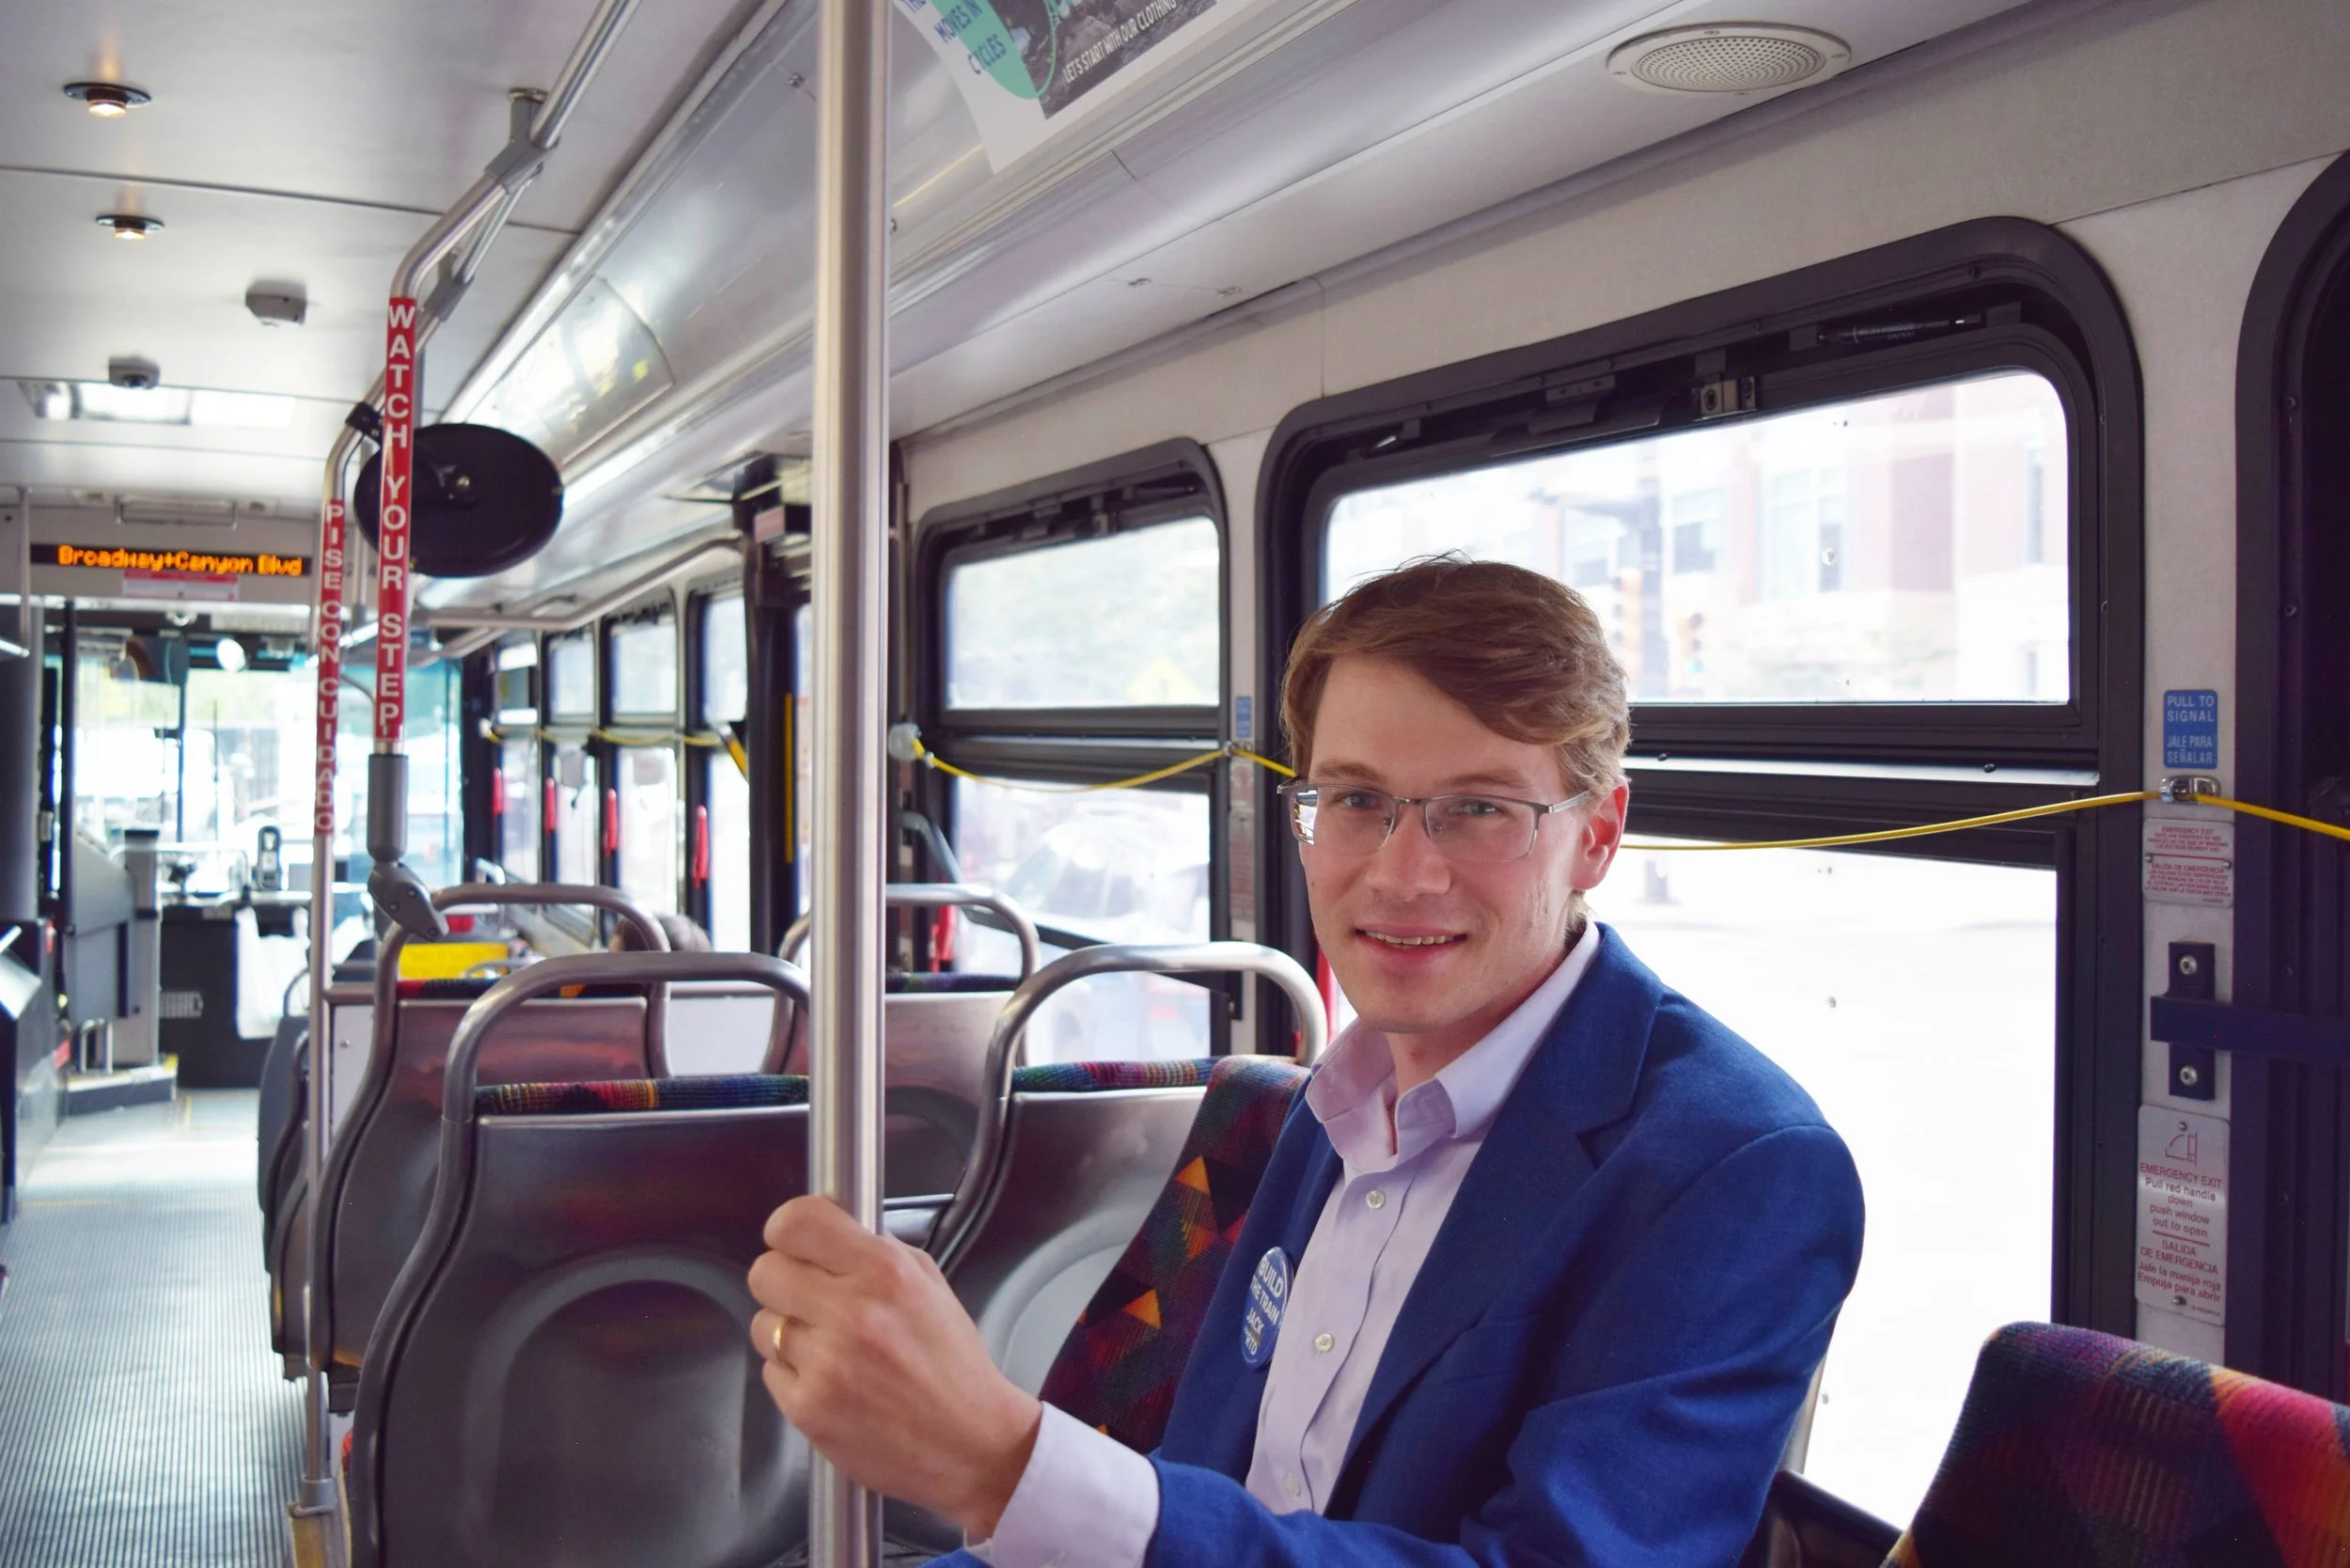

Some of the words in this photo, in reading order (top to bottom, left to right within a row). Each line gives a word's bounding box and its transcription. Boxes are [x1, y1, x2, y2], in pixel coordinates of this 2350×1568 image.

[933, 5, 972, 44] MOVES
[967, 33, 1007, 75] CYCLES
[1081, 40, 1104, 71] START
[1103, 29, 1123, 55] WITH
[1120, 18, 1140, 42] OUR
[387, 305, 415, 448] WATCH
[382, 476, 407, 589] YOUR
[323, 505, 344, 589] PISE
[258, 554, 302, 576] Blvd
[320, 601, 341, 663] CON
[2167, 696, 2194, 707] PULL
[2199, 696, 2215, 707] TO
[2167, 710, 2215, 722] SIGNAL
[2167, 735, 2187, 747] JALE
[2189, 735, 2213, 748] PARA
[2167, 748, 2213, 764] SEÑALAR
[2139, 1162, 2199, 1184] EMERGENCY
[2201, 1176, 2222, 1188] EXIT
[2145, 1177, 2163, 1189] Pull
[2165, 1182, 2181, 1193] red
[2184, 1185, 2217, 1201] handle
[2168, 1194, 2193, 1208] down
[2150, 1204, 2173, 1217] push
[2175, 1208, 2210, 1225] window
[2153, 1217, 2169, 1229] out
[2170, 1220, 2181, 1231] to
[2183, 1225, 2208, 1238] open
[2140, 1247, 2154, 1259] DE
[2155, 1251, 2218, 1275] EMERGENCIA
[2161, 1240, 2197, 1256] SALIDA
[1258, 1258, 1284, 1298] BUILD
[2138, 1261, 2157, 1274] Jale
[2170, 1269, 2201, 1286] manija
[2201, 1278, 2221, 1292] roja
[2138, 1272, 2172, 1290] Empuja
[2174, 1283, 2196, 1296] para
[2198, 1286, 2221, 1303] abrir
[1250, 1276, 1262, 1300] THE
[1260, 1289, 1280, 1326] TRAIN
[1246, 1308, 1264, 1335] JACK
